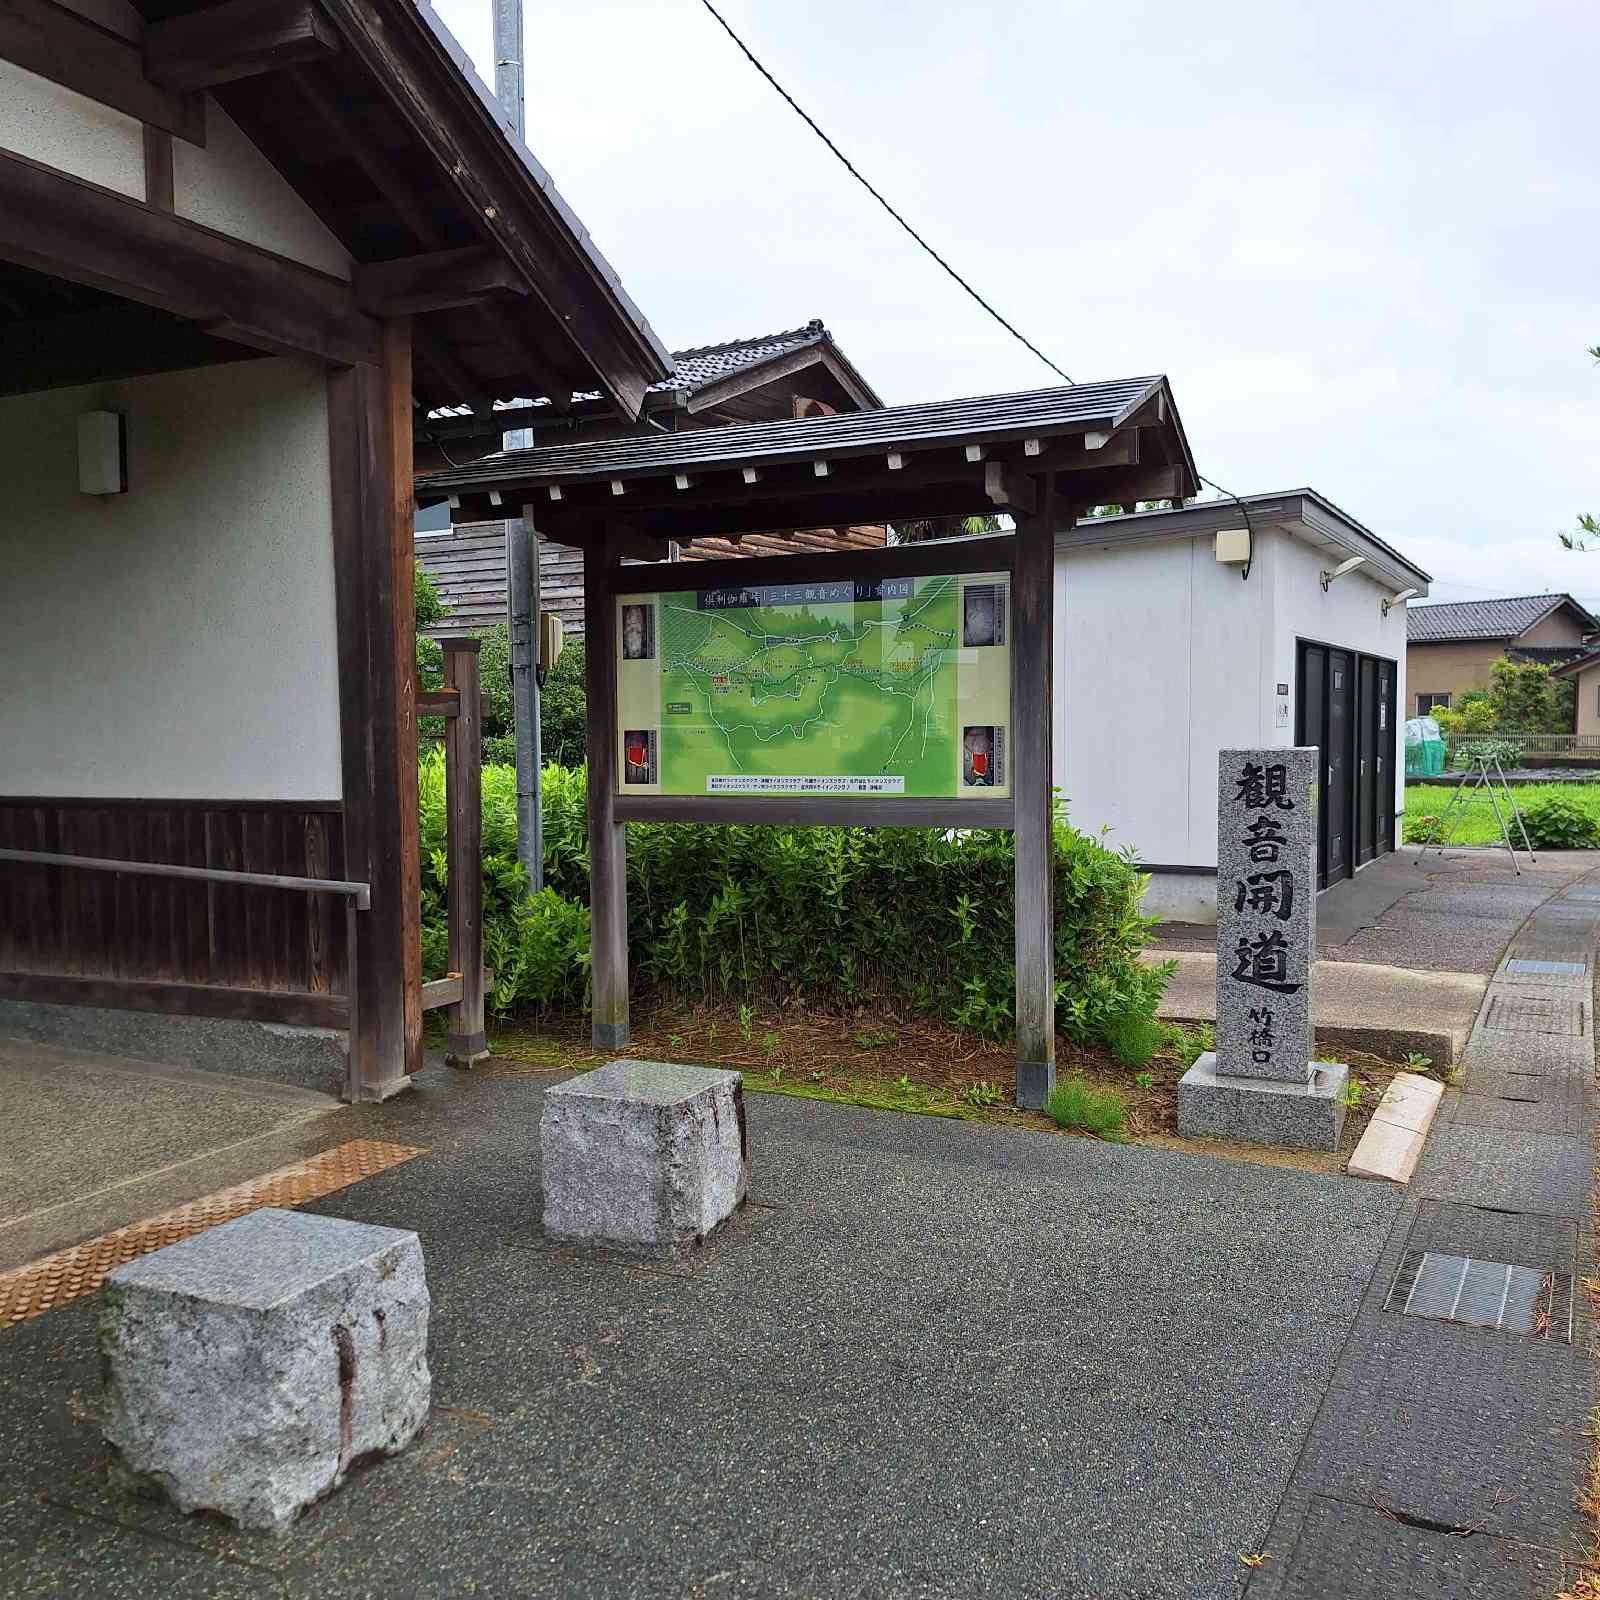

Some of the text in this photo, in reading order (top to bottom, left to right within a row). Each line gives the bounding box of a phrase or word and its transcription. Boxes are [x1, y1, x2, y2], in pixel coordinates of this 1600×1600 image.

[1230, 762, 1303, 995] 観音開道
[1248, 1007, 1275, 1063] 竹橋口
